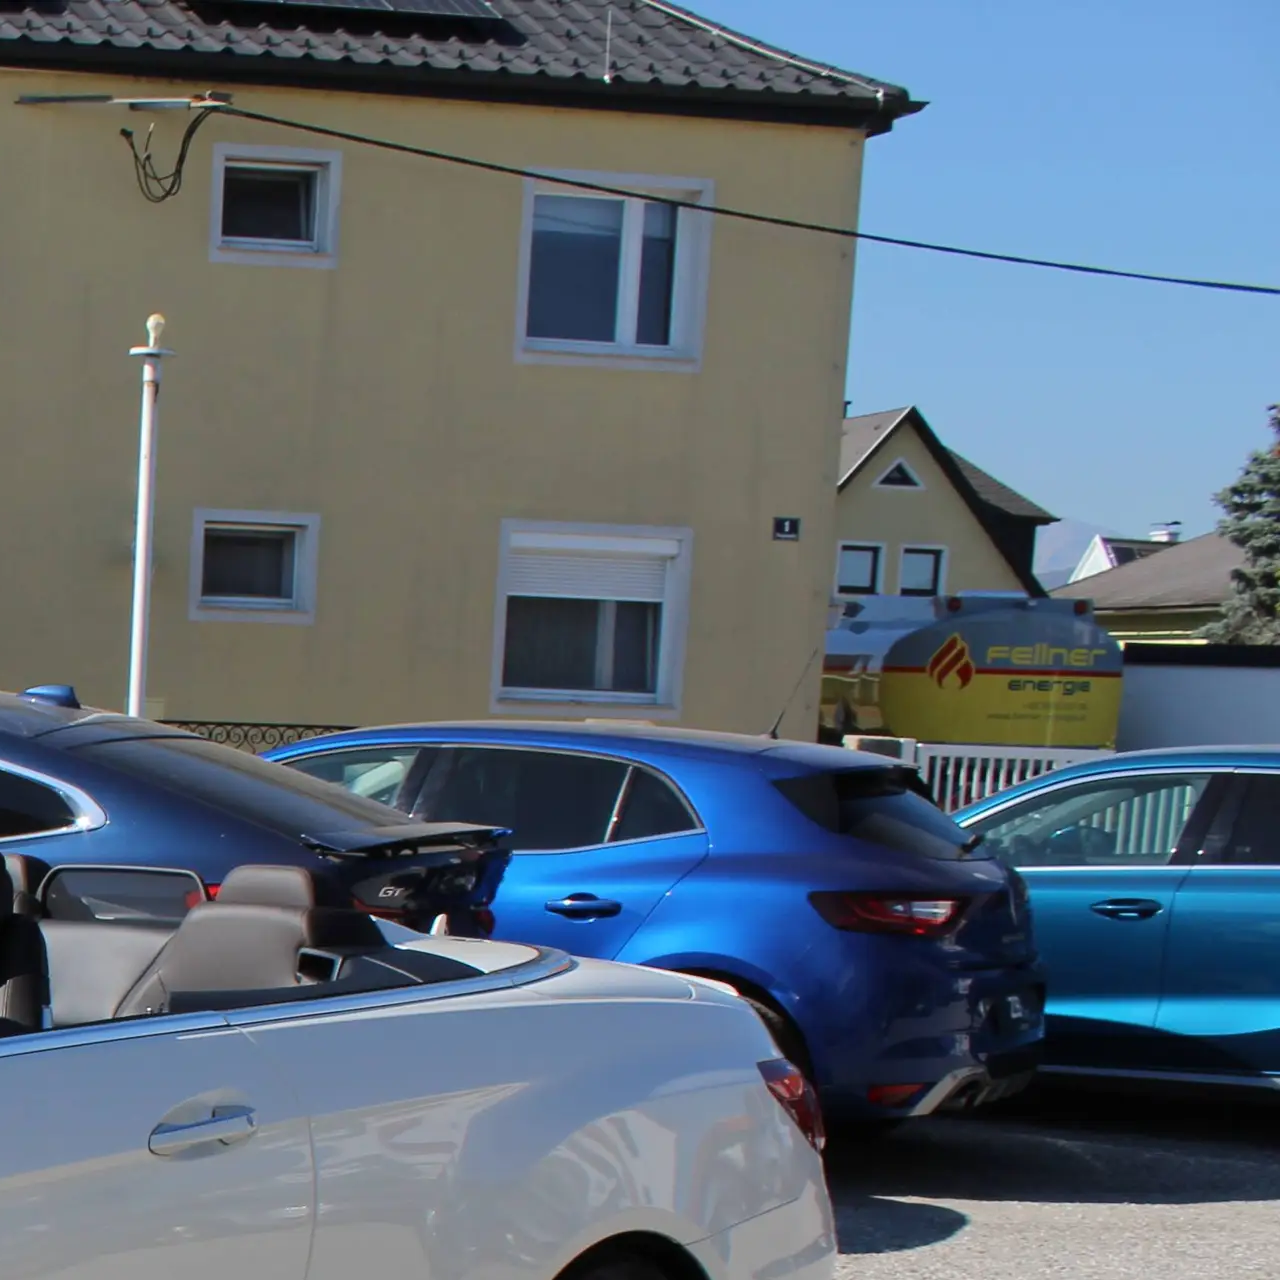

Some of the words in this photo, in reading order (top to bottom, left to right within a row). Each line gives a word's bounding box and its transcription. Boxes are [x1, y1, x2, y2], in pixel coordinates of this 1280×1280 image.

[784, 520, 790, 532] 1
[986, 643, 1107, 666] Fellner
[1008, 679, 1091, 695] energie
[378, 886, 405, 897] GT
